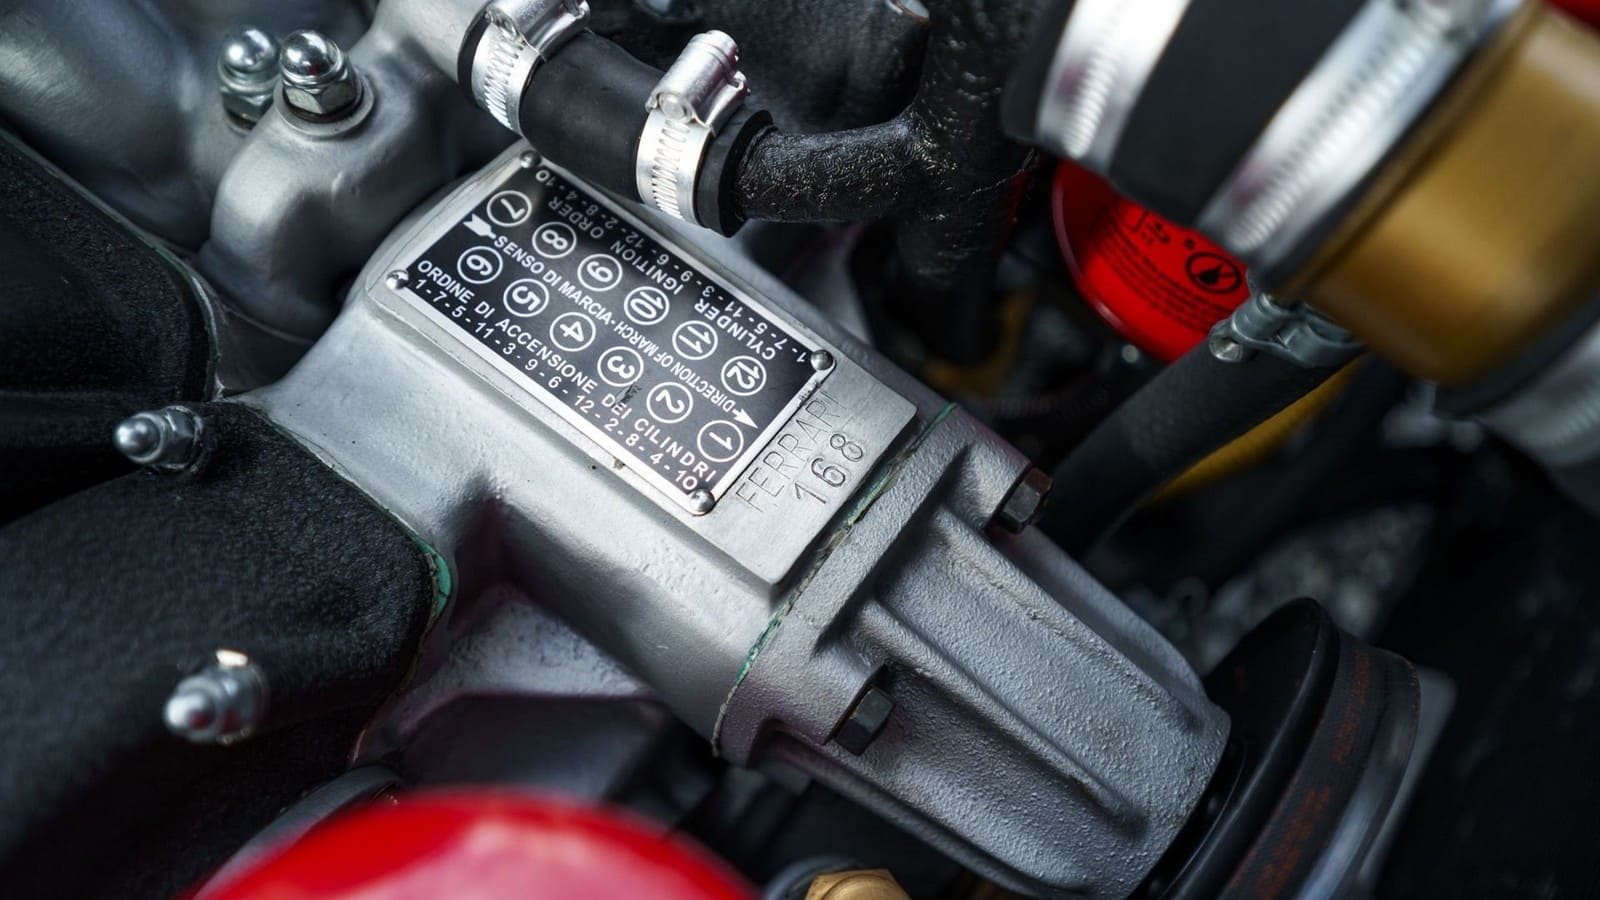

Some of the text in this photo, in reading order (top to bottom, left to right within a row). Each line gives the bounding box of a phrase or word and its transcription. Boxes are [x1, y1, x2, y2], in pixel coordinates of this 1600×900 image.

[494, 235, 545, 274] SENSO
[542, 269, 562, 287] DI
[547, 196, 776, 360] CYLINDER IGNITION ORDER
[417, 260, 717, 482] ORDINE DI ACCENSIONE DEI CILINDRI
[613, 320, 736, 413] DIRECTION OF MARCH
[736, 390, 846, 512] FERRARI
[793, 433, 864, 504] 168
